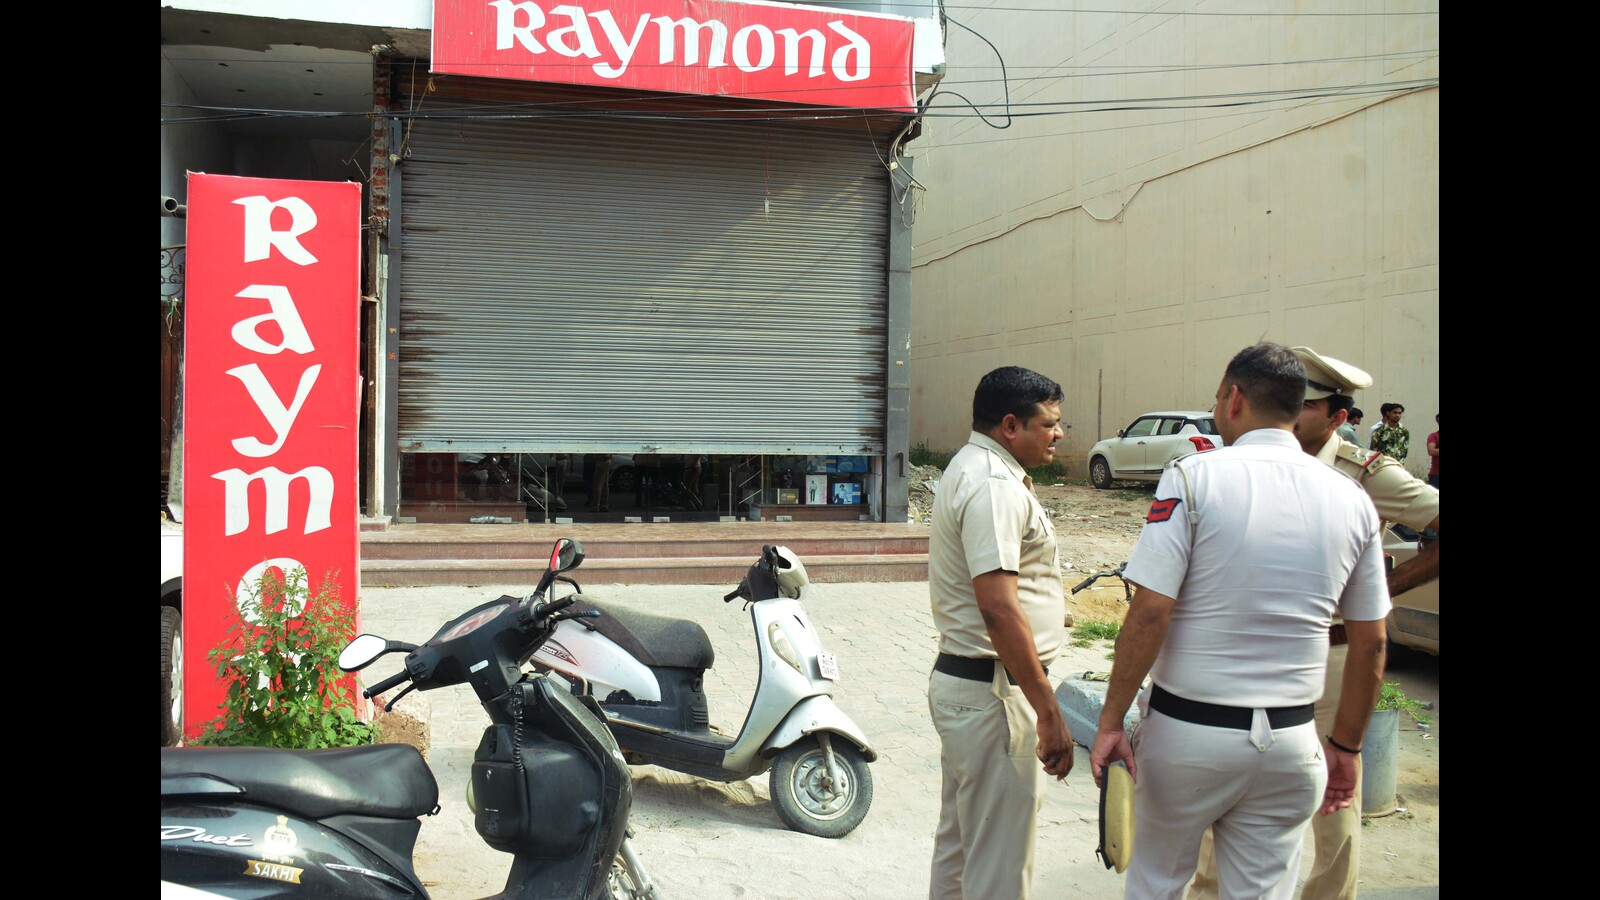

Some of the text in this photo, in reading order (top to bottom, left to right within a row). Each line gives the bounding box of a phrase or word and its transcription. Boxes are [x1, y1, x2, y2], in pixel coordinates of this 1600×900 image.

[488, 0, 870, 82] Raymond
[161, 825, 253, 846] Duet
[253, 862, 295, 880] SAKHI
